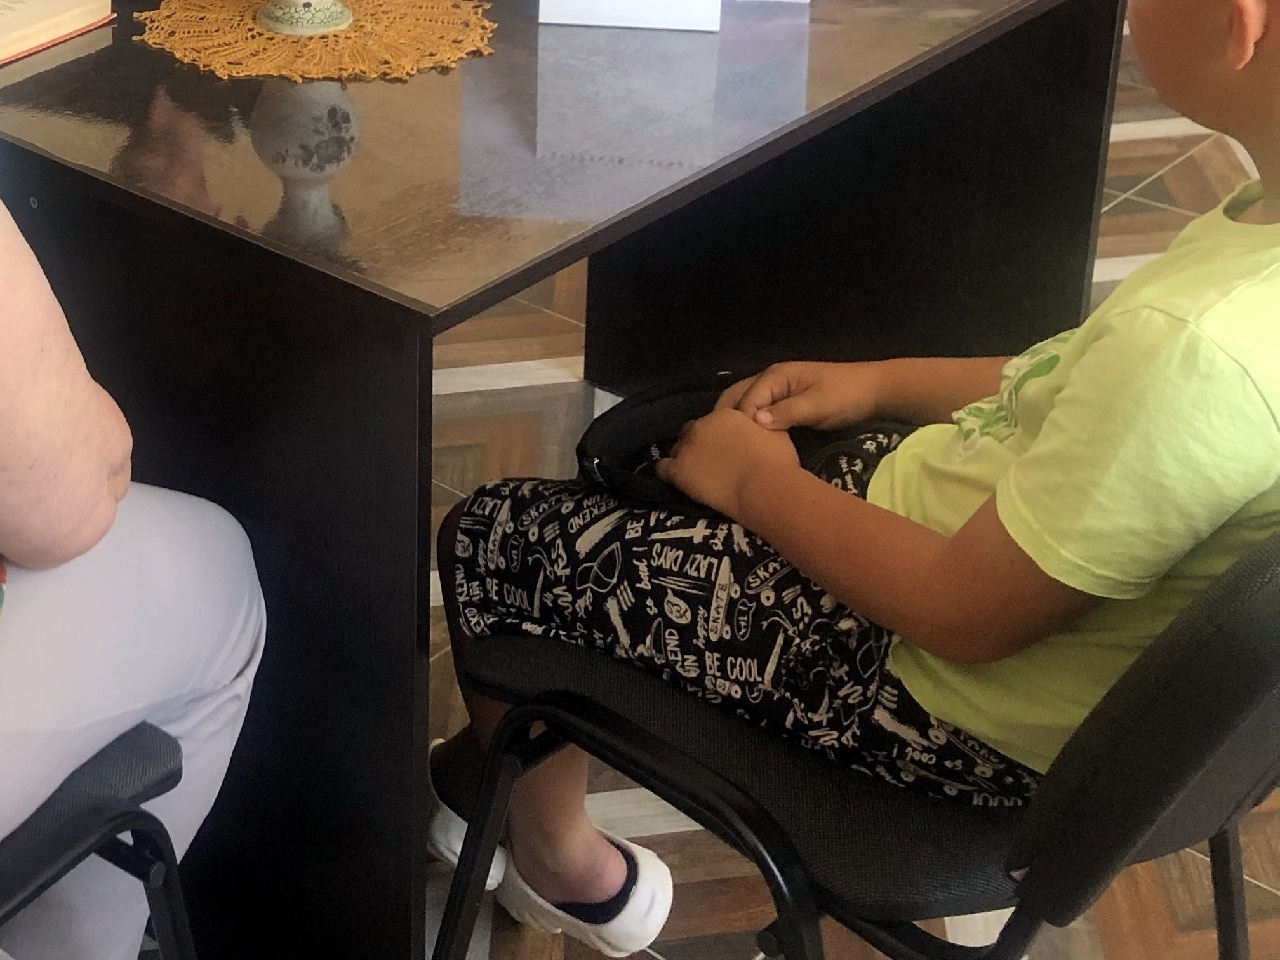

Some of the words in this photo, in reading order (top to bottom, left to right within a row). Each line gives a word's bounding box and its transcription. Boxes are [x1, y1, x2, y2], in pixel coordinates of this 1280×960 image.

[650, 542, 684, 572] DAYS
[683, 553, 719, 581] LAZY
[485, 577, 499, 601] BE
[709, 582, 728, 635] SKATE
[705, 651, 721, 676] BE
[727, 656, 762, 682] COOL
